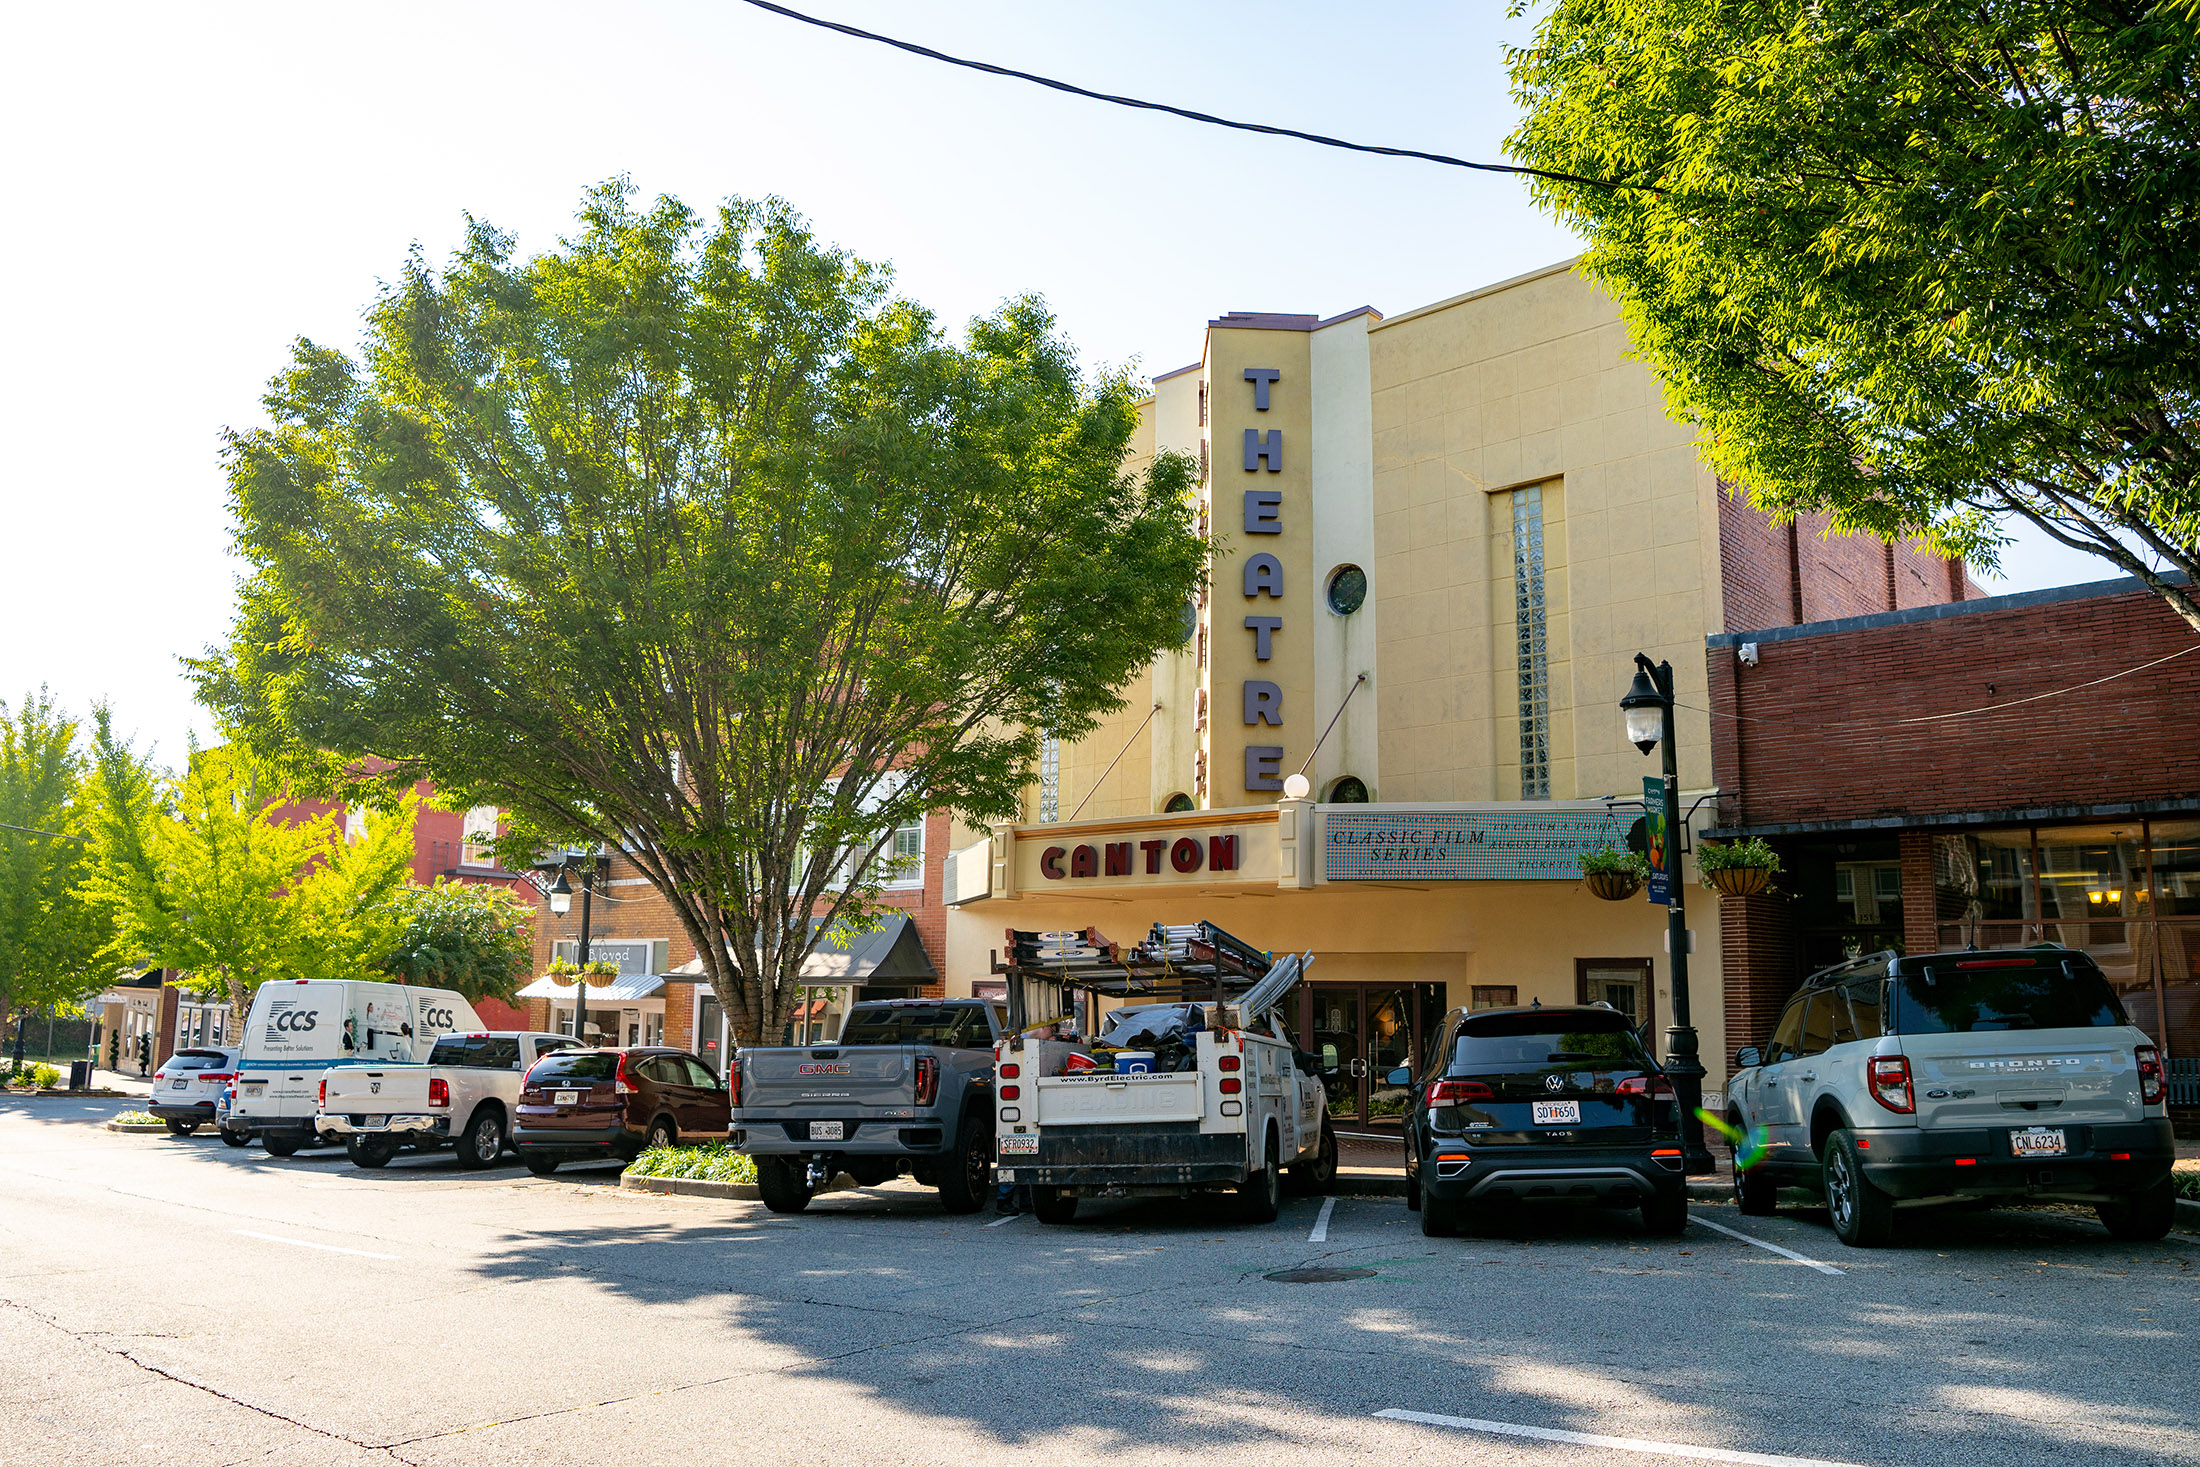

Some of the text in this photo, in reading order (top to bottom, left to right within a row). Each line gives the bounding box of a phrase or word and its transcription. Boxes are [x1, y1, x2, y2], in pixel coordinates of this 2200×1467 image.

[1244, 368, 1283, 791] THEATRE
[1513, 823, 1556, 831] CATCH
[1560, 823, 1568, 831] A
[1333, 830, 1485, 844] CLASSIC FILM
[1488, 840, 1541, 849] AUGUST
[1545, 840, 1576, 849] 23RD
[1040, 834, 1240, 880] CANTON
[1371, 847, 1447, 861] SERIES
[1517, 861, 1572, 869] TICKETS
[276, 1010, 319, 1032] CCS
[426, 1007, 453, 1029] CCS
[799, 1063, 851, 1075] GMC
[1970, 1058, 2081, 1069] BRONCO
[1060, 1073, 1173, 1083] www.ByrdElectric.com
[1062, 1088, 1176, 1112] READING
[1004, 1139, 1035, 1149] SFR0932
[2015, 1135, 2061, 1149] CNL6234
